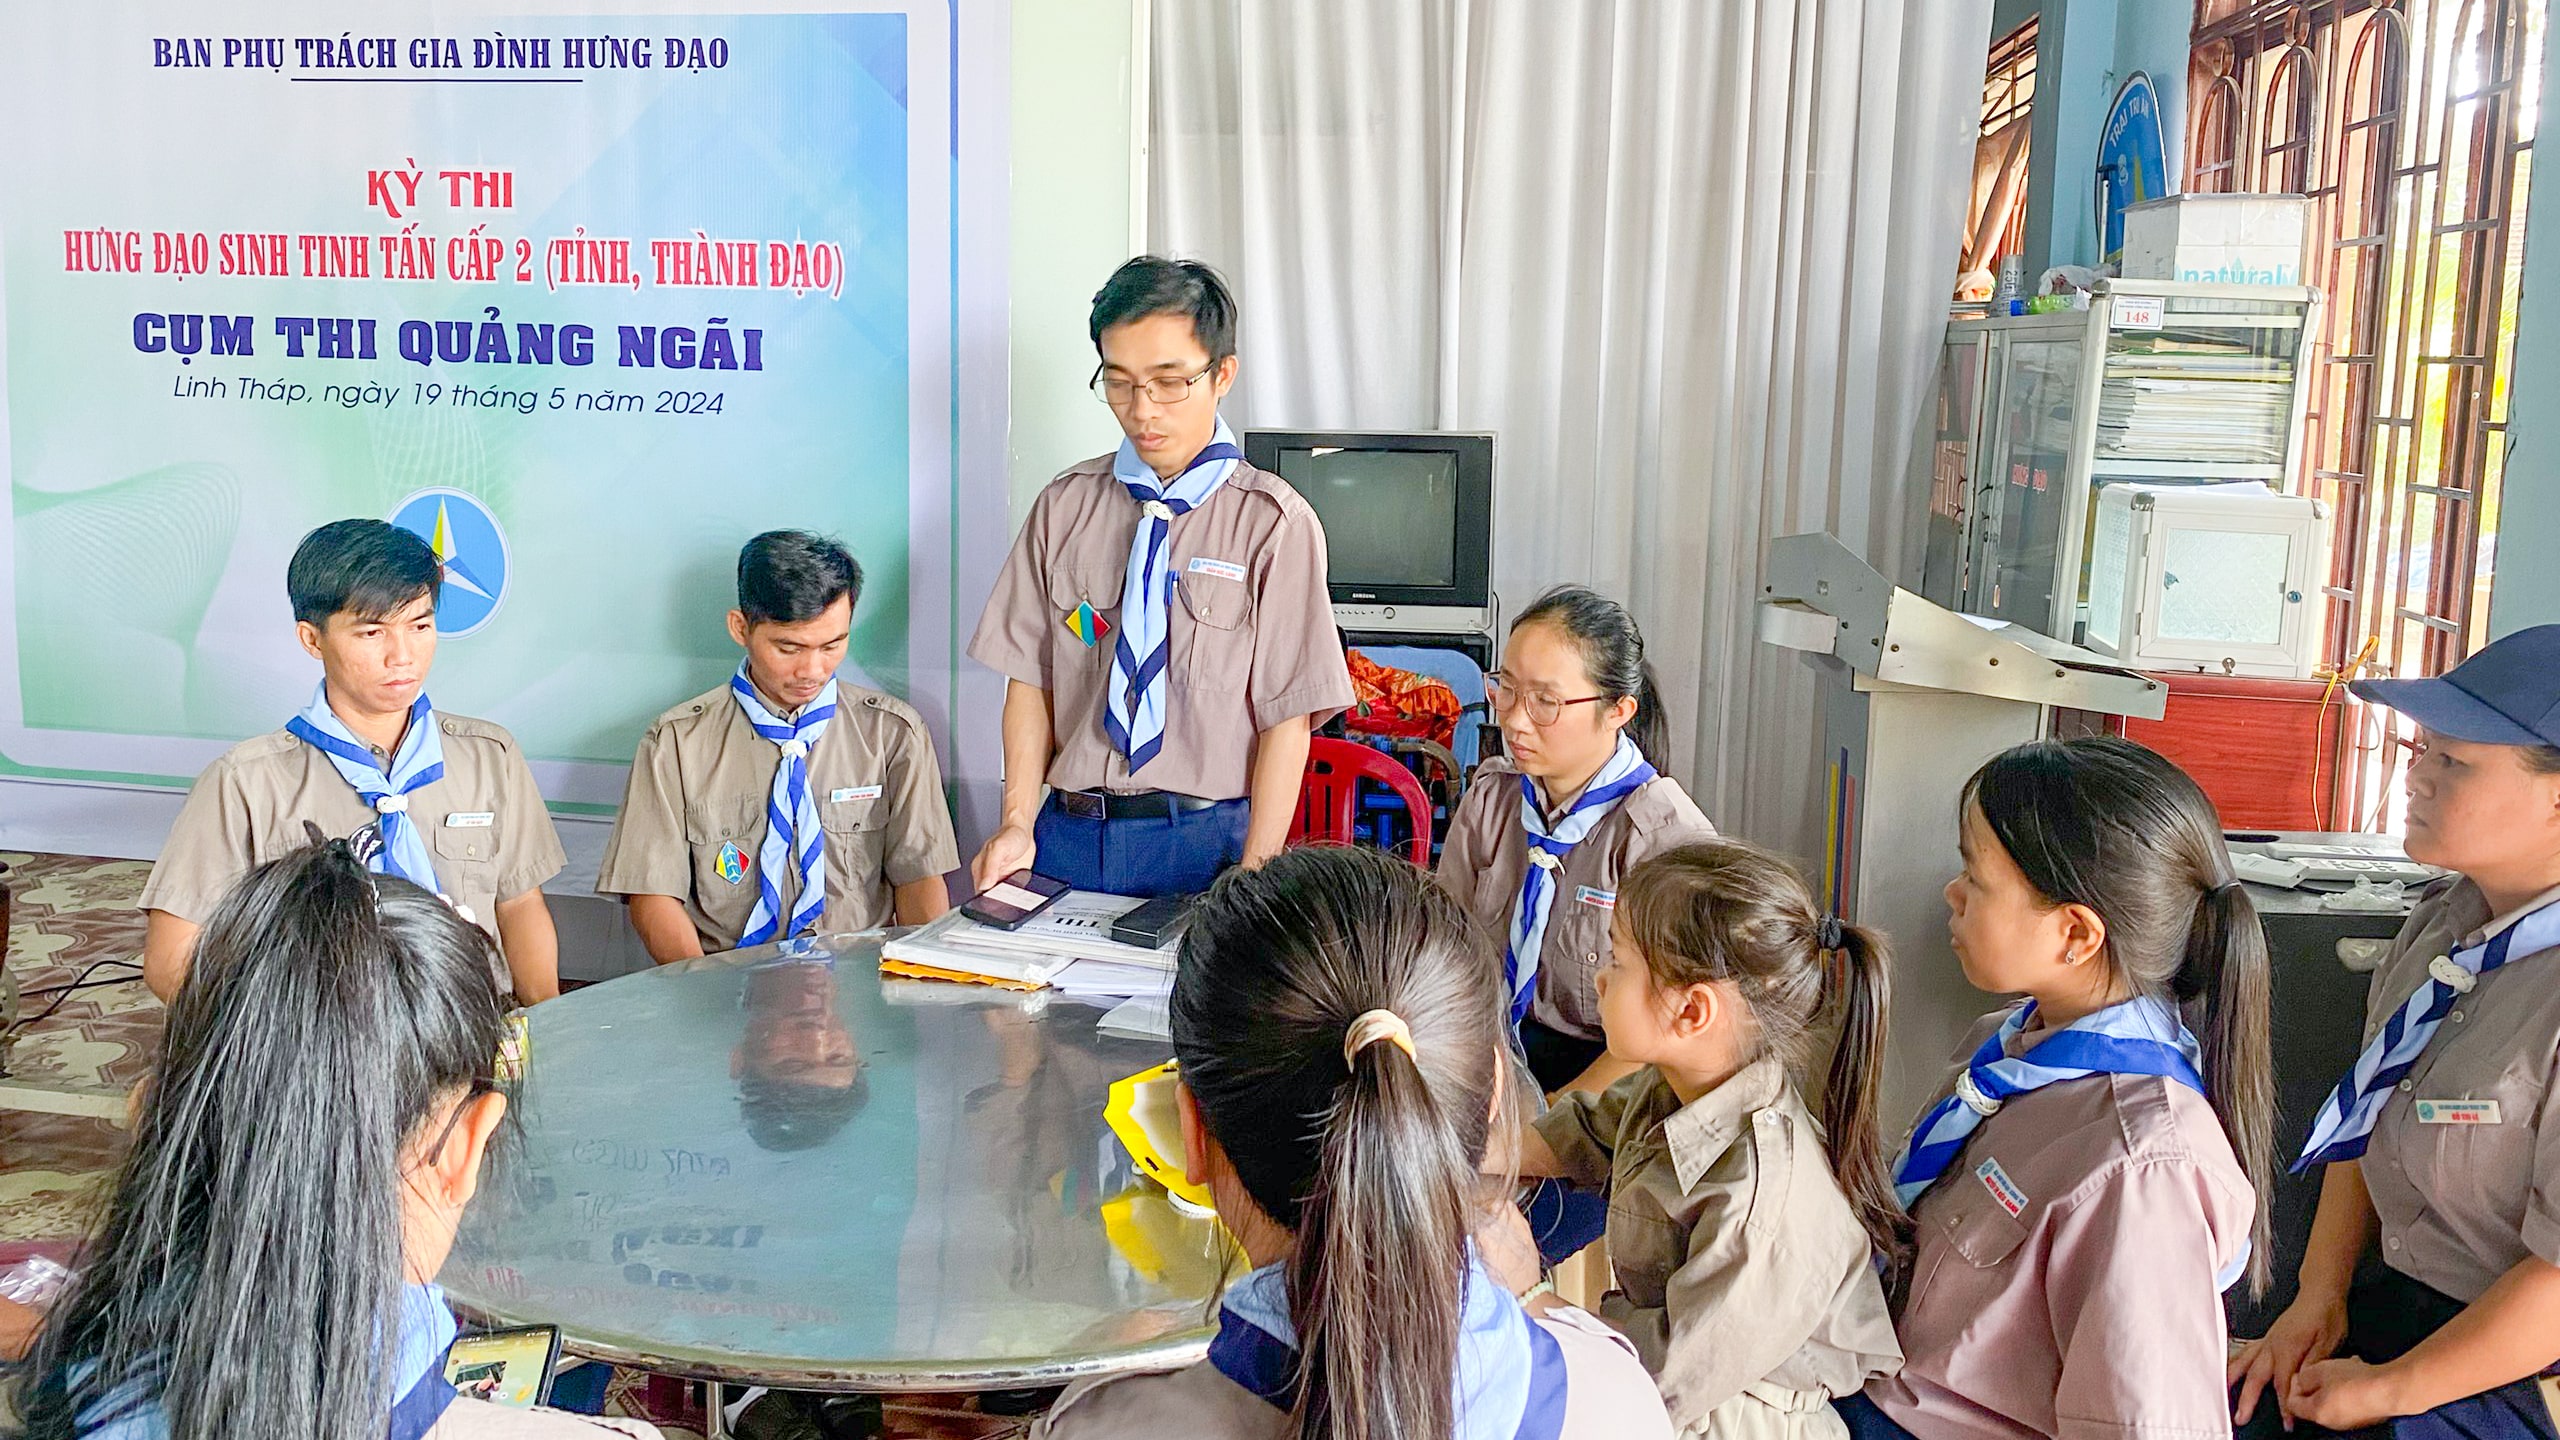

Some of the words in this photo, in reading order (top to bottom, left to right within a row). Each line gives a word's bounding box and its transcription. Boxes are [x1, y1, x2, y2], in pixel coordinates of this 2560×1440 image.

[153, 38, 211, 68] BAN
[223, 38, 284, 75] PHỤ
[295, 32, 397, 69] TRÁCH
[409, 38, 462, 69] GIA
[473, 30, 551, 69] ĐÌNH
[562, 35, 652, 69] HƯNG
[664, 38, 729, 74] ĐẠO
[367, 157, 423, 218] KỲ
[439, 171, 512, 208] THI
[64, 229, 141, 273] HƯNG
[153, 232, 208, 277] ĐẠO
[219, 233, 288, 277] SINH
[299, 235, 369, 278] TINH
[379, 221, 435, 280] TẤN
[447, 229, 503, 281] CẤP
[515, 238, 532, 282] 2
[546, 226, 641, 290] (TỈNH,
[651, 231, 758, 287] THÀNH
[769, 243, 844, 298] ĐẠO)
[2183, 264, 2283, 285] natural
[133, 313, 254, 367] CỤM
[275, 316, 378, 361] THI
[398, 306, 594, 368] QUẢNG
[617, 317, 763, 372] NGÃI
[2125, 311, 2149, 323] 148
[173, 375, 227, 399] Linh
[238, 376, 313, 408] Tháp,
[323, 381, 401, 410] ngày
[415, 382, 442, 406] 19
[451, 384, 539, 415] tháng
[548, 387, 566, 410] 5
[575, 389, 644, 413] năm
[654, 390, 724, 415] 2024
